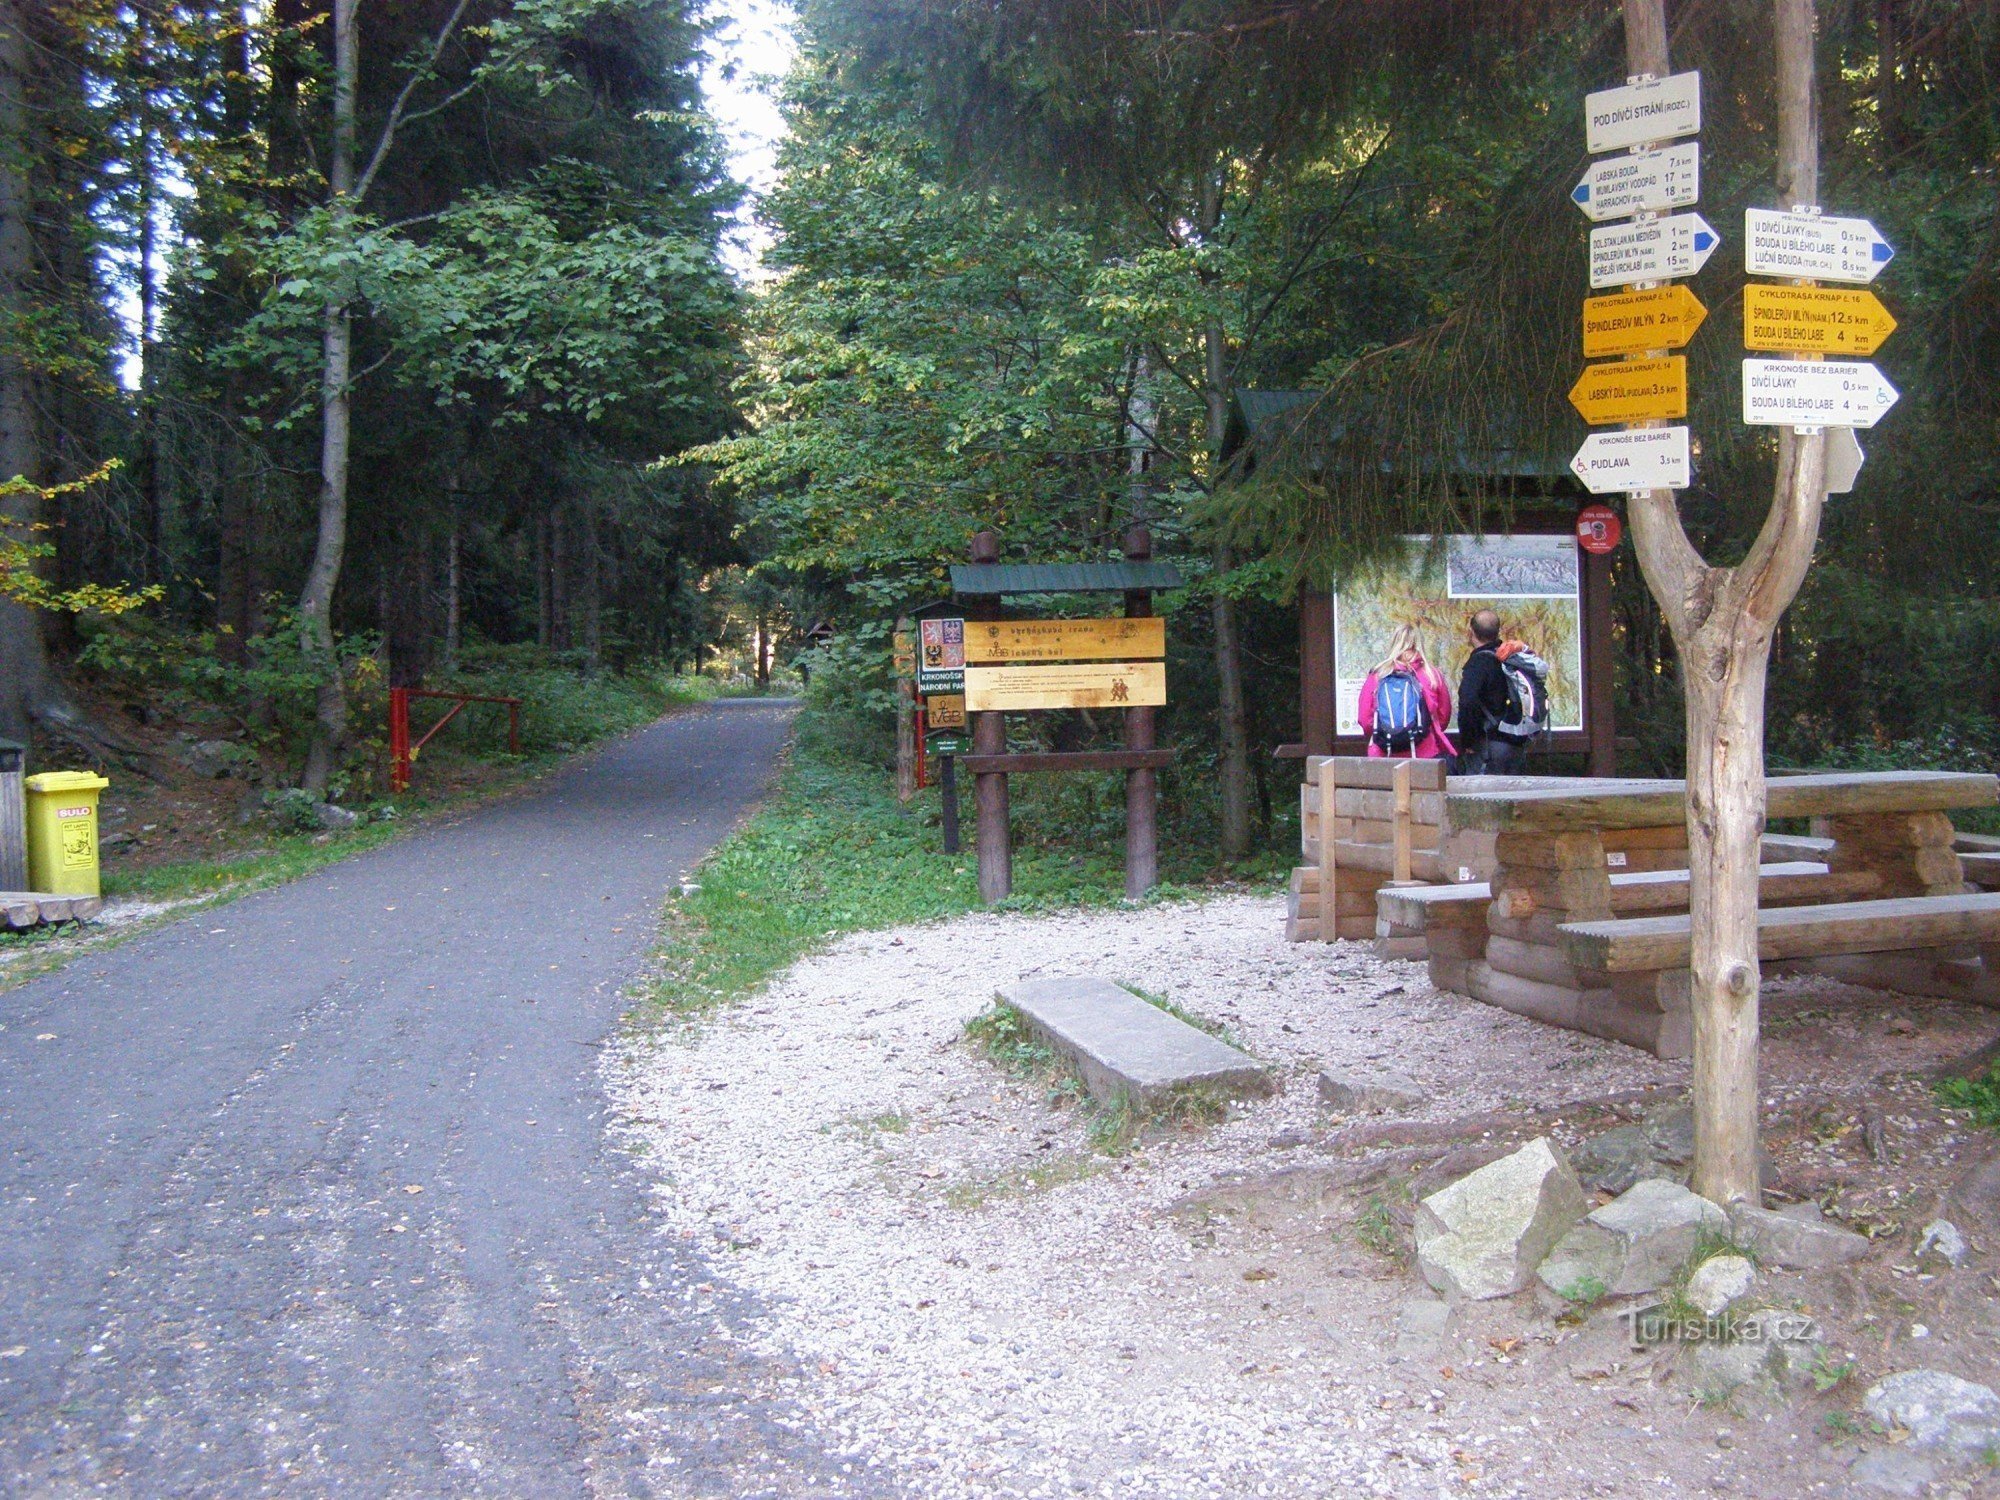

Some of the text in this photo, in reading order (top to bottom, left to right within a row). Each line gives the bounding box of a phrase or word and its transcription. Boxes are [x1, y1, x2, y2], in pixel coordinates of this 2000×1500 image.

[1594, 100, 1690, 127] POD DÍVČÍ STRÁNÍ (ROZC.)
[1596, 167, 1618, 182] LABSKÁ
[1619, 166, 1638, 178] BOUDA
[1670, 158, 1680, 167] 7,5
[1630, 174, 1656, 189] VODOPÁD
[1665, 172, 1674, 183] 17
[1596, 194, 1631, 209] HARRACHOV
[1665, 186, 1675, 196] 18
[1672, 227, 1676, 236] 1
[1755, 222, 1760, 232] U
[1762, 221, 1780, 234] DÍVČÍ
[1782, 223, 1805, 236] LÁVKY
[1806, 230, 1822, 239] (BUS)
[1841, 230, 1854, 242] 0,5
[1593, 248, 1624, 263] ŠPINDLERŮV
[1624, 246, 1639, 258] MLÝN
[1672, 242, 1677, 250] 2
[1755, 236, 1780, 248] BOUDA
[1782, 239, 1787, 250] U
[1790, 238, 1815, 252] BÍLÉHO
[1817, 243, 1836, 254] LABE
[1842, 246, 1848, 256] 4
[1593, 262, 1615, 276] HOŘEJŠÍ
[1616, 259, 1642, 273] VRCHLABÍ
[1667, 256, 1677, 266] 15
[1755, 250, 1776, 263] LUČNÍ
[1778, 254, 1802, 266] BOUDA
[1842, 260, 1854, 271] 8,5
[1856, 264, 1866, 272] km
[1592, 298, 1634, 309] CYKLOTRASA
[1635, 294, 1657, 303] KRNAP
[1760, 290, 1812, 300] CYKLOTRASA
[1814, 292, 1842, 302] KRNAP
[1587, 315, 1632, 334] ŠPINDLERŮV
[1634, 312, 1654, 327] MLÝN
[1660, 313, 1666, 324] 2
[1754, 305, 1792, 321] ŠPINDLERŮV
[1793, 308, 1810, 322] MLÝN
[1830, 312, 1852, 324] 12,5
[1855, 316, 1868, 324] km
[1754, 325, 1868, 343] BOUDA U BÍLÉHO LABE 4 km
[1592, 366, 1633, 377] CYKLOTRASA
[1634, 364, 1656, 373] KRNAP
[1764, 364, 1808, 374] KRKONOŠE
[1828, 366, 1858, 374] BARIÉR
[1752, 374, 1770, 388] DÍVČÍ
[1772, 376, 1796, 388] LÁVKY
[1843, 380, 1856, 392] 0,5
[1588, 385, 1613, 400] LABSKÝ
[1614, 386, 1626, 398] DŮL
[1652, 384, 1665, 395] 3,5
[1666, 386, 1678, 394] km
[1752, 396, 1779, 407] BOUDA
[1780, 398, 1785, 408] U
[1786, 396, 1813, 409] BÍLÉHO
[1815, 399, 1834, 410] LABE
[1843, 400, 1850, 410] 4
[1598, 432, 1671, 446] KRKONOŠE BEZ BARIÉR
[1591, 458, 1630, 469] PUDLAVA
[1660, 455, 1670, 465] 3,5
[921, 672, 964, 681] KRKONOŠSK
[920, 682, 951, 691] NÁRODNÍ
[59, 807, 90, 818] SULO
